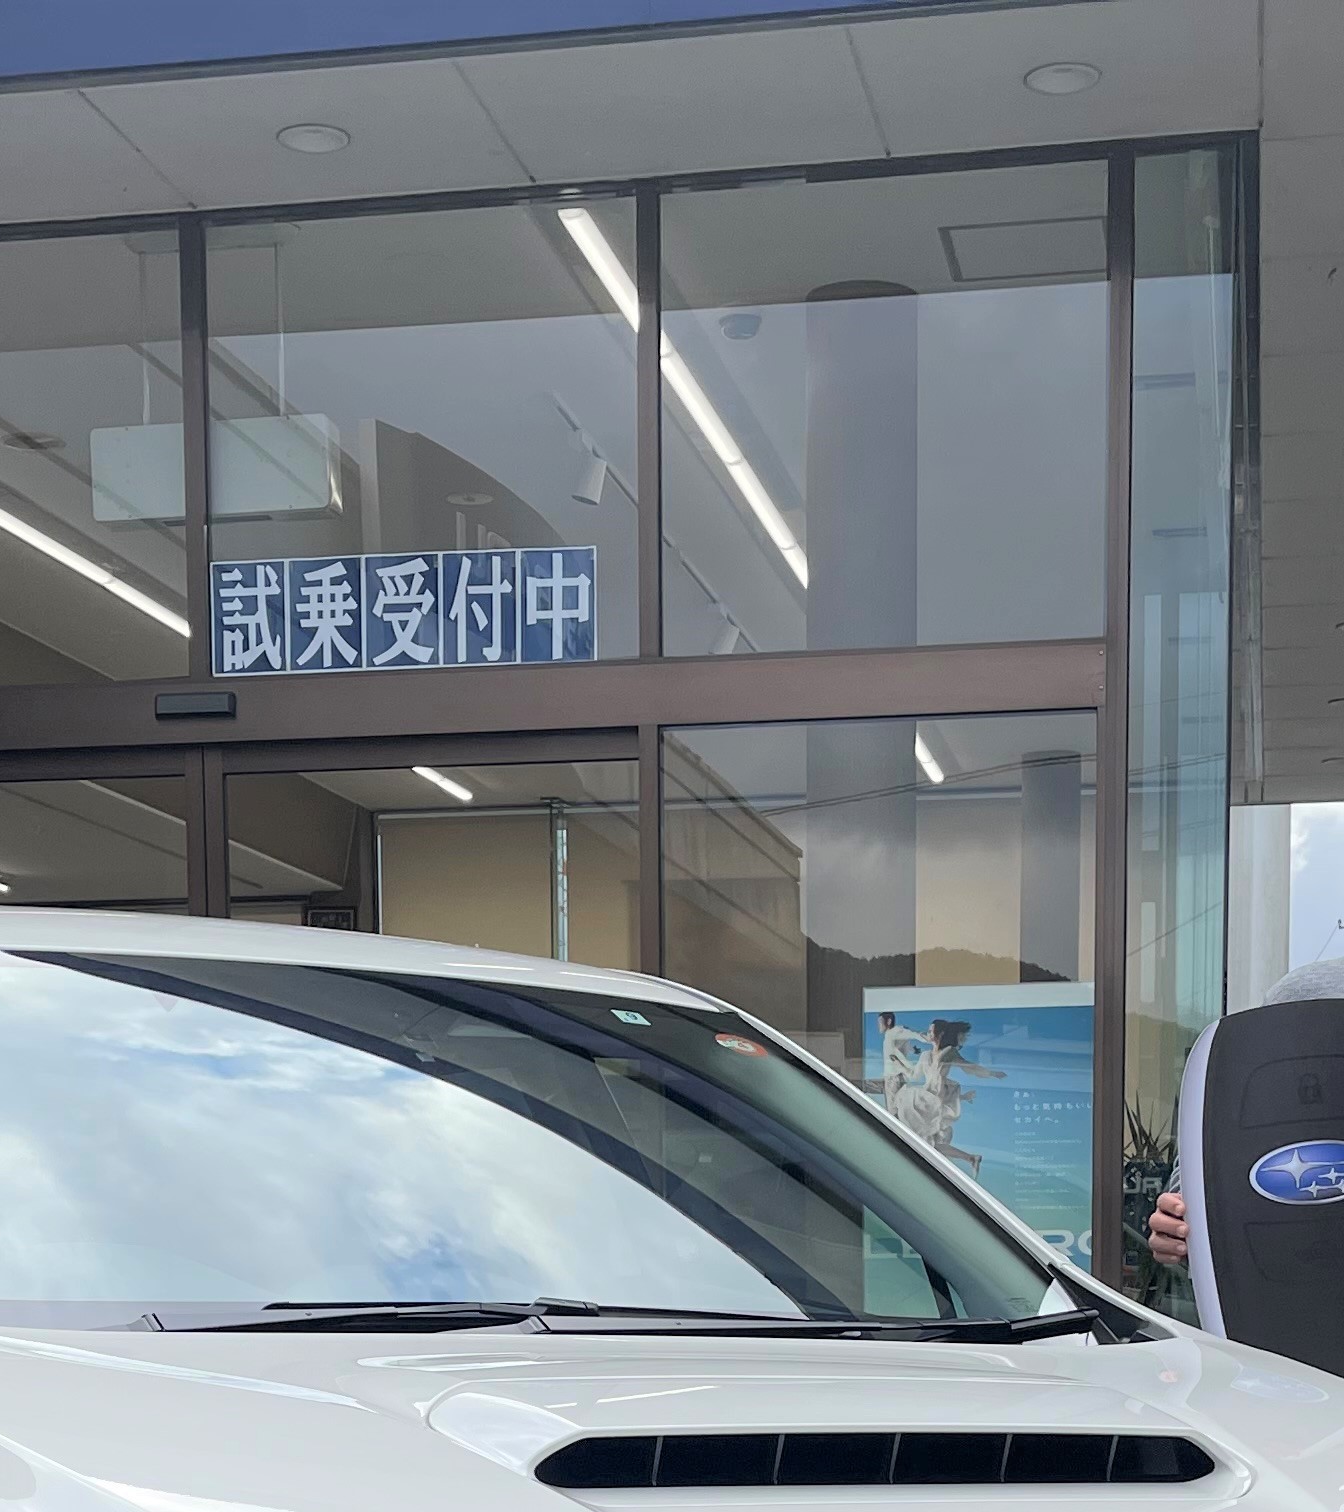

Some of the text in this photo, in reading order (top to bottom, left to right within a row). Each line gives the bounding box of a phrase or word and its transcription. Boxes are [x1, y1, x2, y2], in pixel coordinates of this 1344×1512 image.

[218, 552, 592, 673] 試乗受付中
